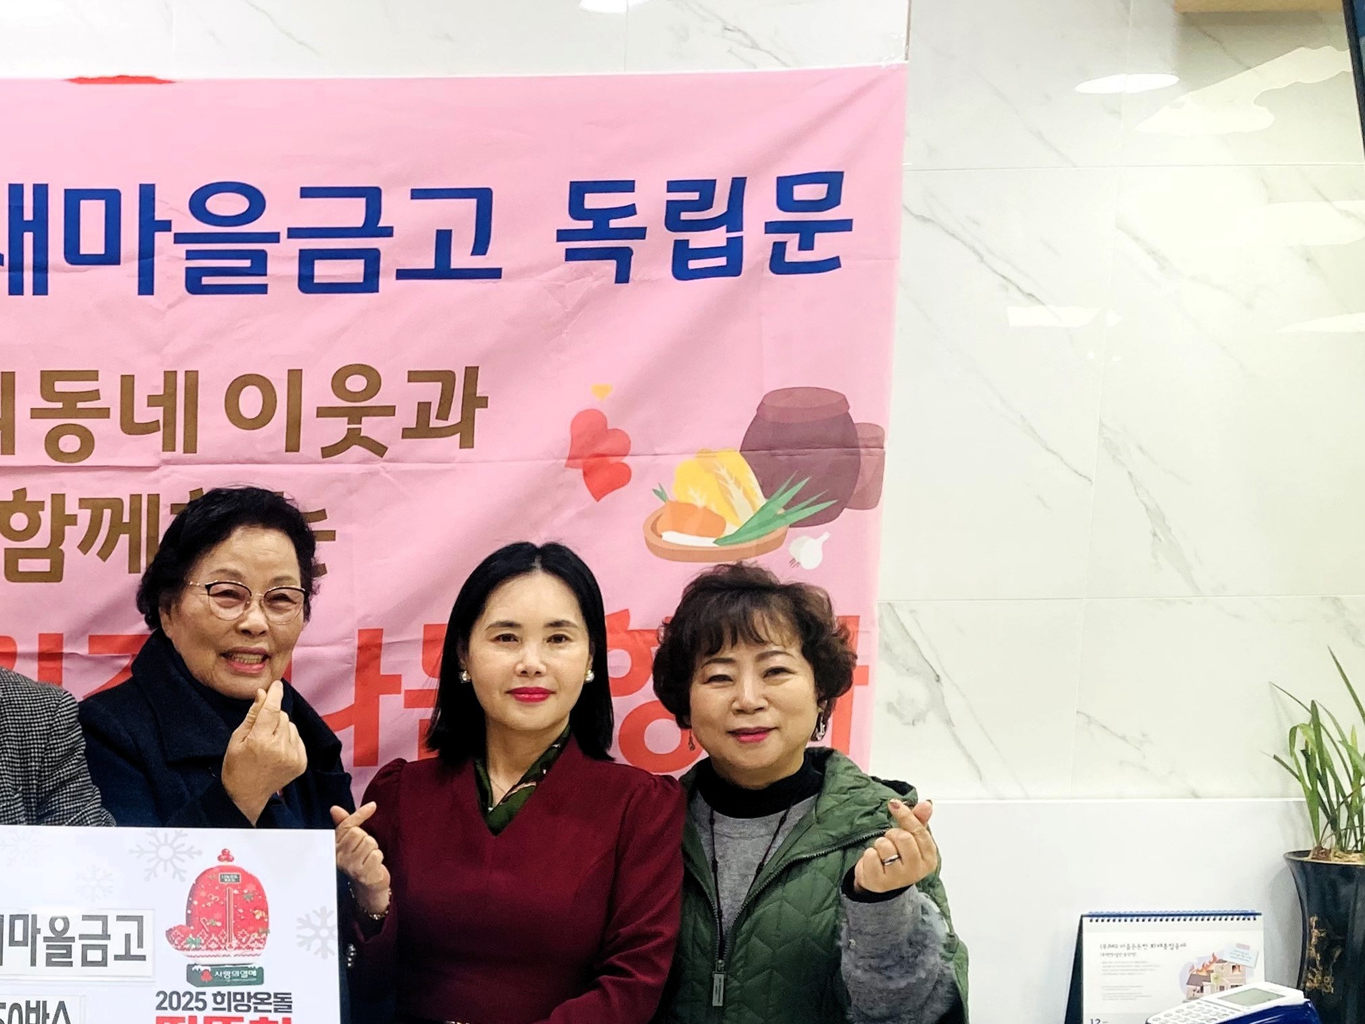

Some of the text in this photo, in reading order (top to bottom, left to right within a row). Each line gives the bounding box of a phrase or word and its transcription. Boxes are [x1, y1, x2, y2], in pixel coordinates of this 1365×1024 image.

[556, 171, 853, 284] 독립문
[225, 364, 488, 458] 이웃과
[155, 990, 293, 1013] 2025 희망온돌
